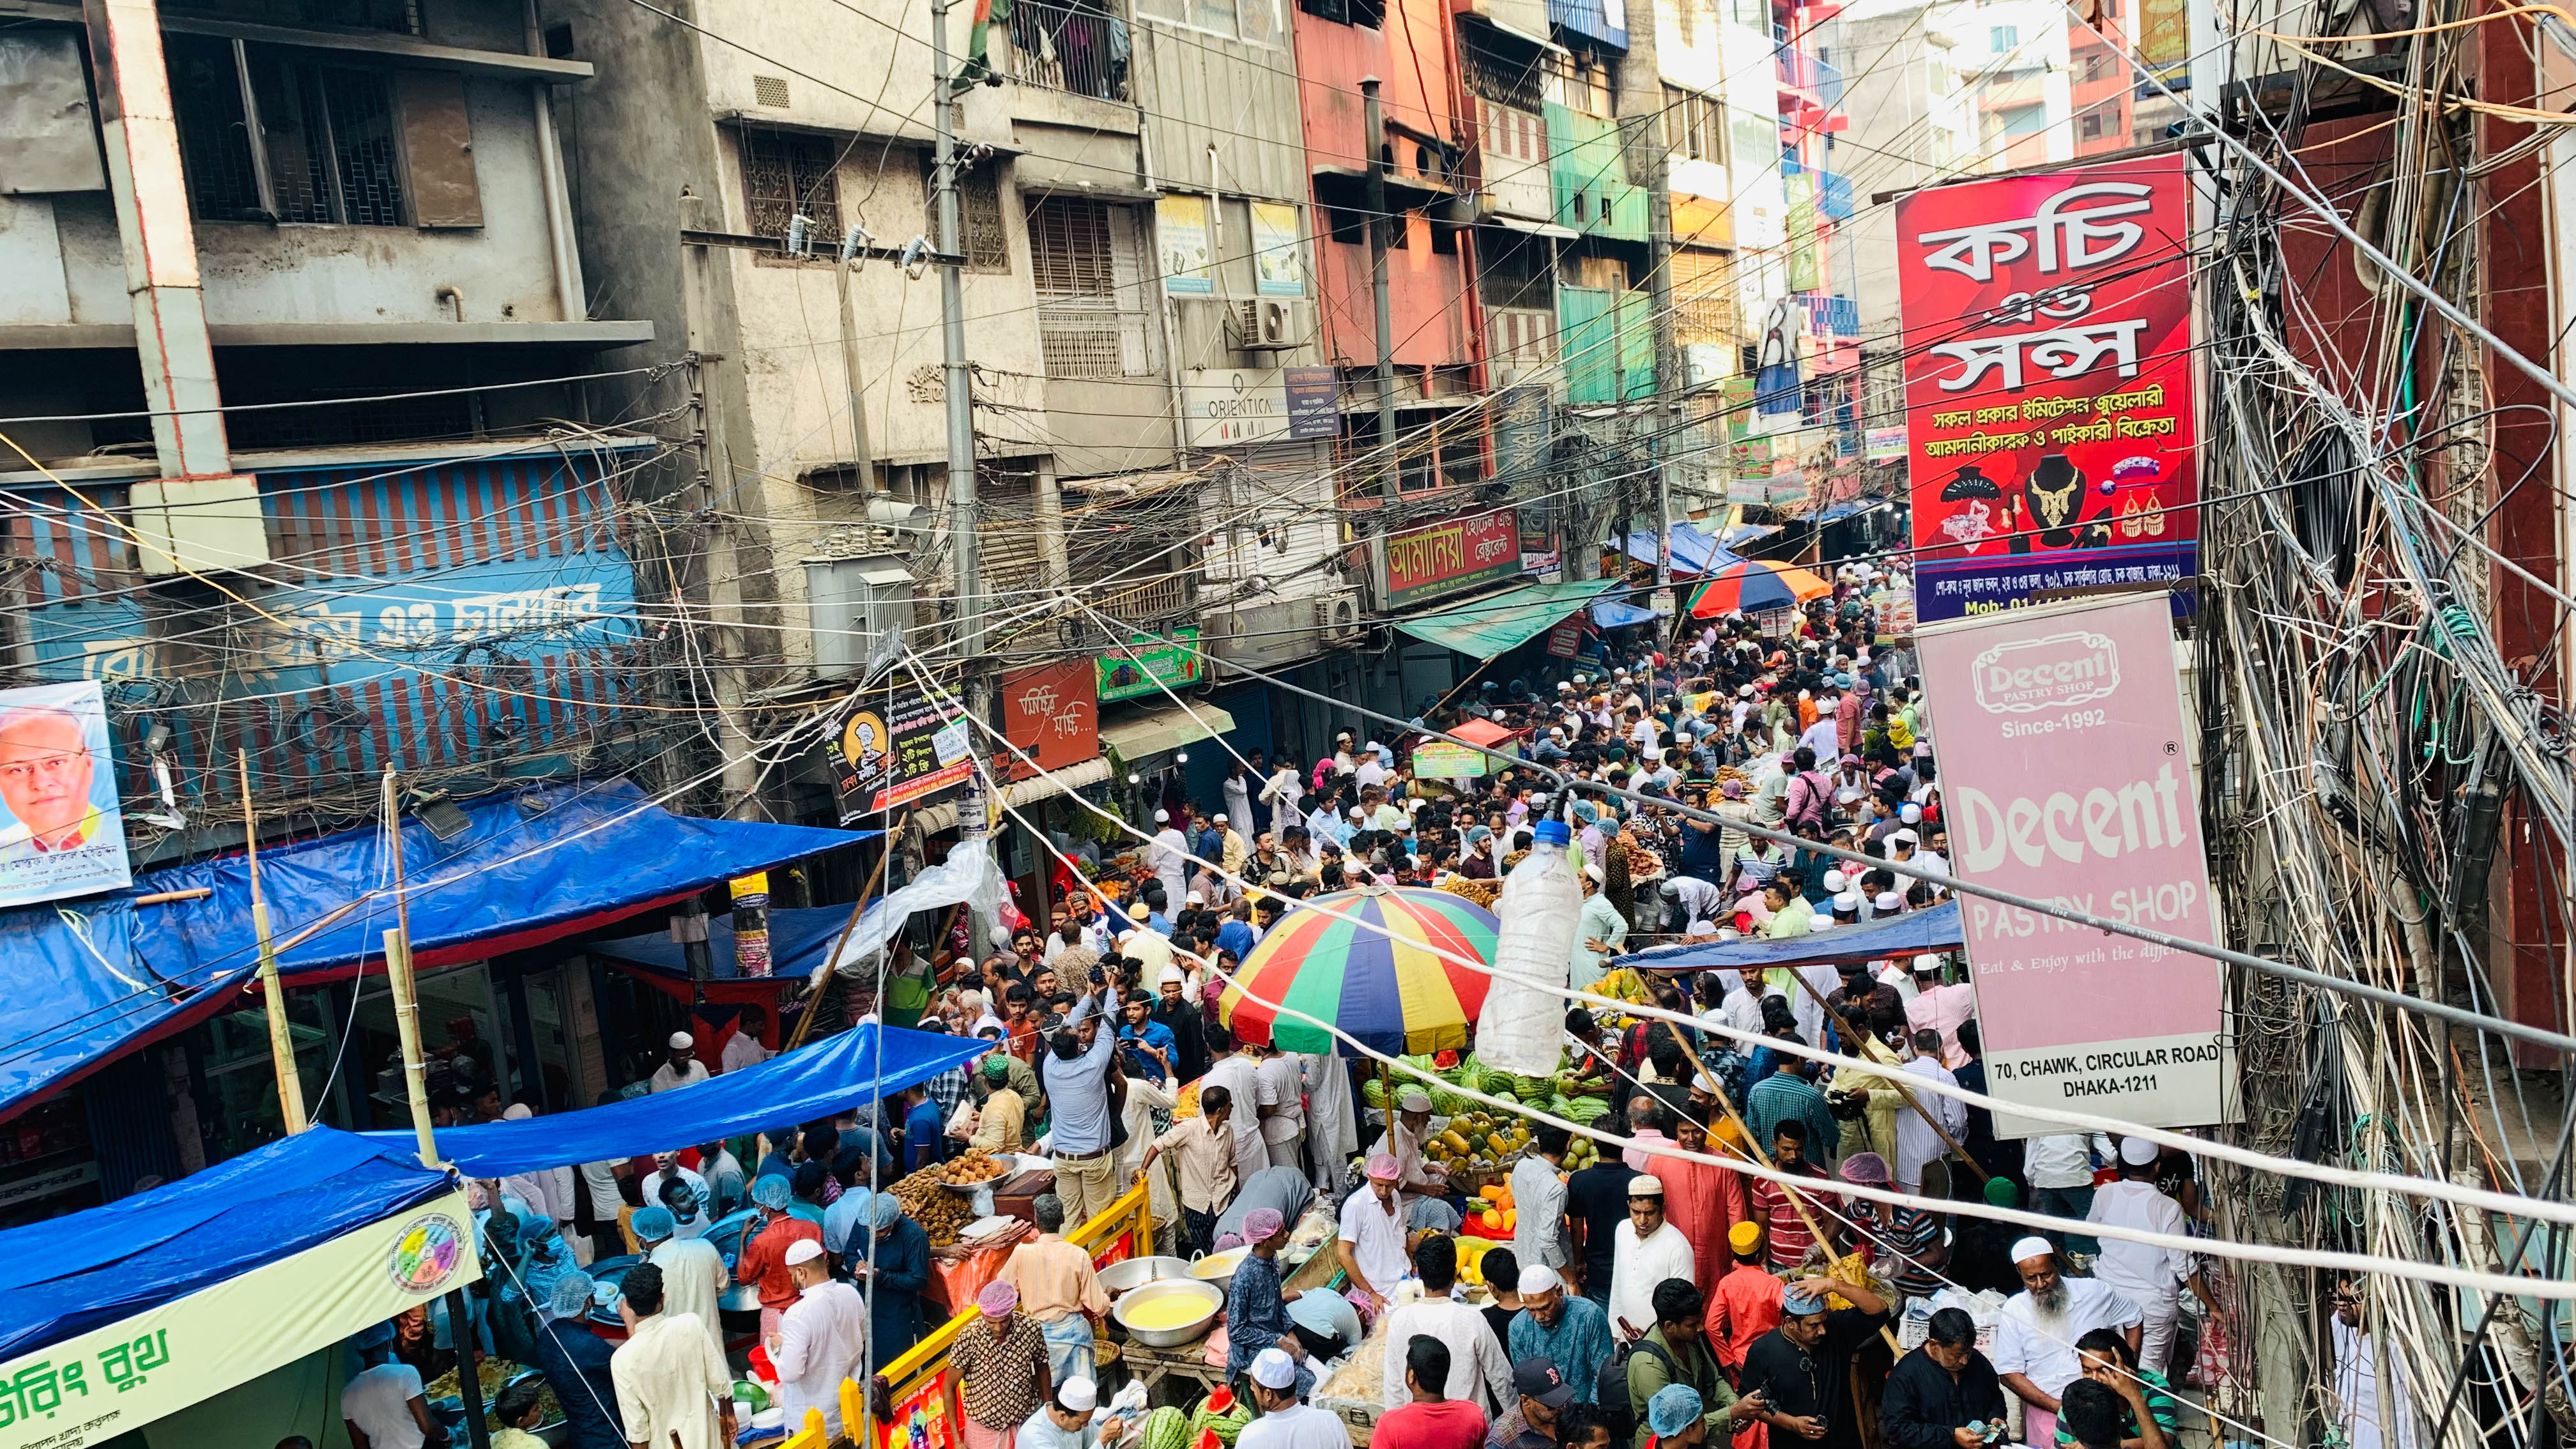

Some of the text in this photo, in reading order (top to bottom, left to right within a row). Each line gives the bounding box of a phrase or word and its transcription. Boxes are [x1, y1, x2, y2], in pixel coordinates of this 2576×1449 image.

[1918, 181, 2154, 281] কচি
[1930, 319, 2147, 392] সন্স
[1209, 397, 1273, 417] ORIENTICA
[1932, 410, 1972, 429] সকল
[1975, 405, 2018, 425] প্রকার
[2095, 384, 2164, 416] জুয়েলারী
[1925, 432, 2030, 458] আমদানীকারক
[2034, 433, 2046, 447] ও
[2051, 419, 2112, 445] পাইকারী
[2117, 416, 2176, 438] বিক্রেতা
[1466, 515, 1496, 537] হোটেল
[1387, 523, 1465, 583] আমানিয়া
[1965, 599, 2005, 615] Mob:
[1989, 652, 2110, 692] Decent
[2004, 680, 2094, 703] PASTRY SHOP
[2002, 709, 2106, 739] Since-1992
[841, 774, 858, 792] ঢাকা
[1956, 762, 2186, 873] Decent
[1973, 880, 2197, 942] PASTRY SHOP
[1979, 959, 2004, 975] Eat
[2011, 959, 2024, 971] &
[2030, 953, 2069, 975] Enjoy
[2075, 945, 2106, 965] with
[2112, 943, 2135, 960] the
[1995, 1043, 2219, 1081] 70, CHAWK, CIRCULAR ROAD
[2064, 1074, 2158, 1098] DHAKA-1211
[97, 1328, 170, 1393] বুথ
